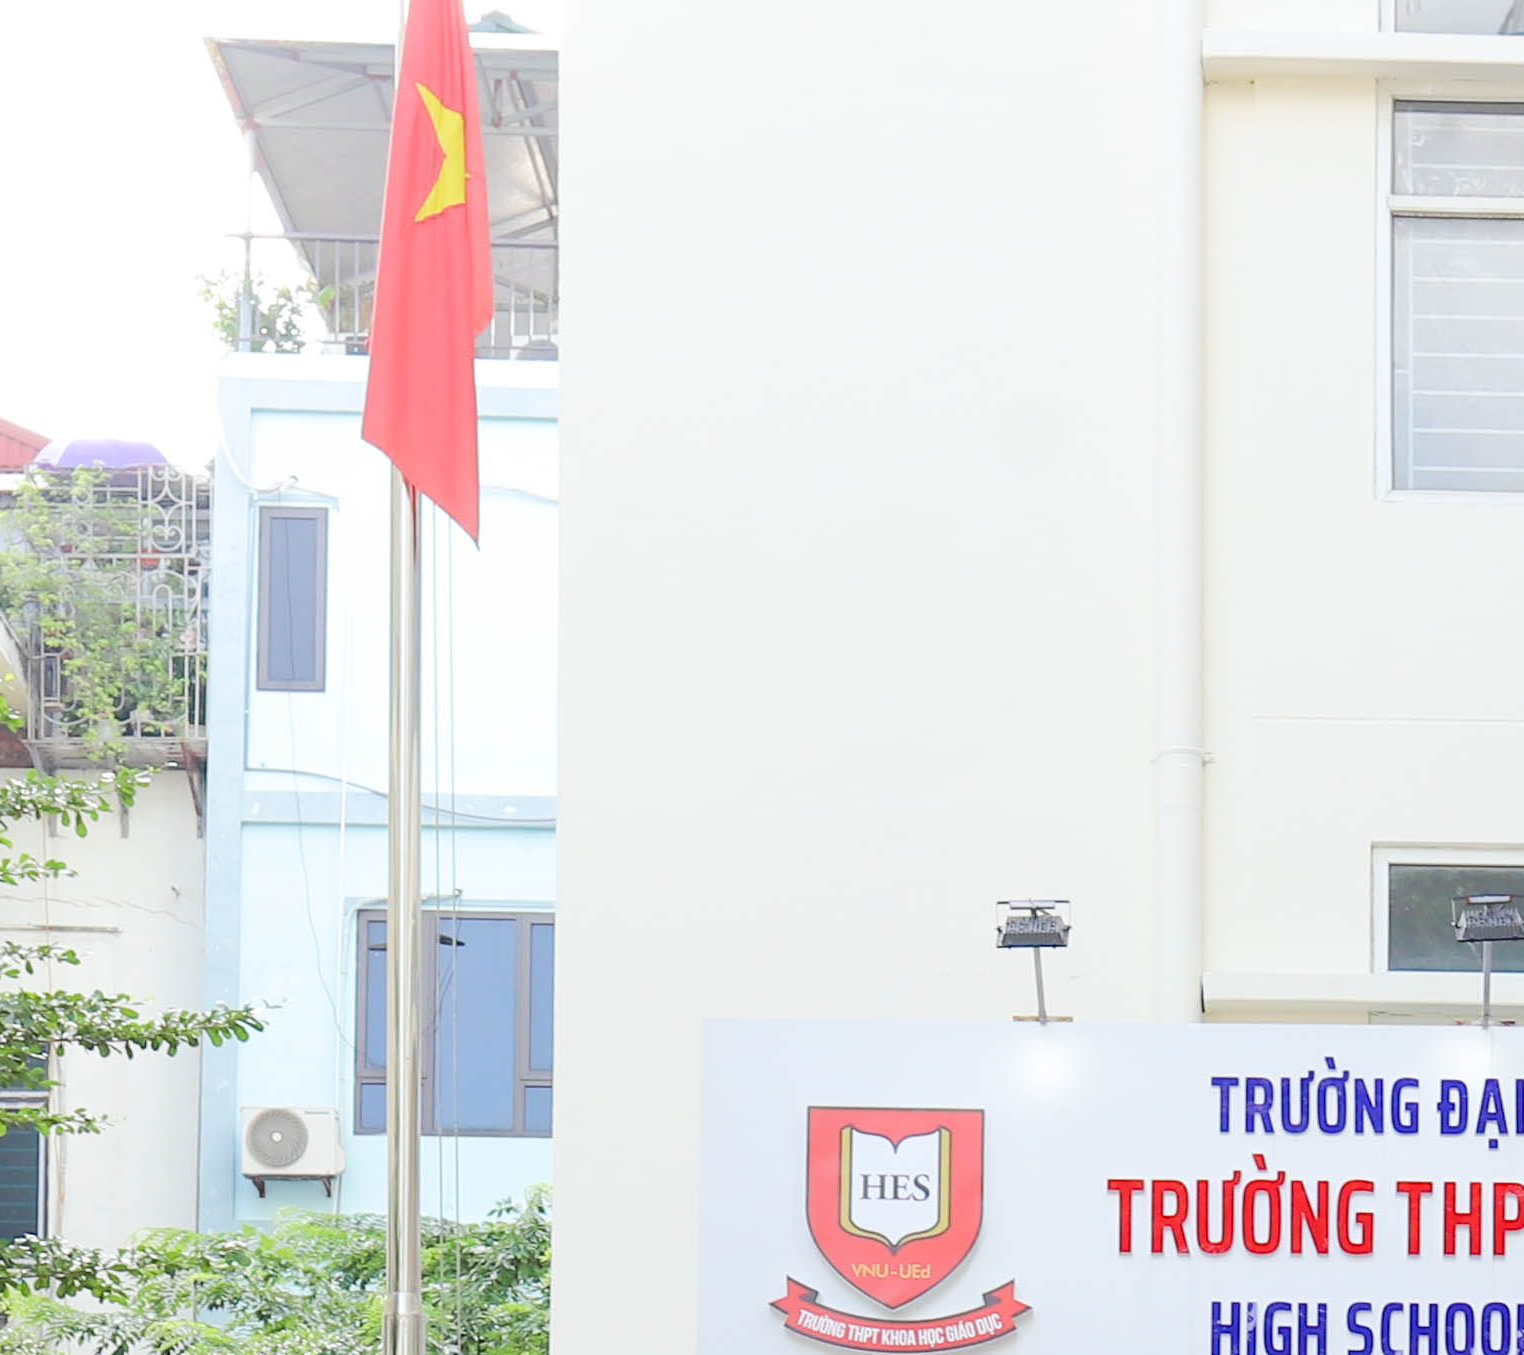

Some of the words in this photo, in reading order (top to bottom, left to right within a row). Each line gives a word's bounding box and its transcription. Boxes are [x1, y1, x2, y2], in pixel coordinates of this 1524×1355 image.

[1210, 1056, 1420, 1135] TRƯỜNG
[859, 1173, 931, 1201] HES
[1107, 1153, 1375, 1256] TRƯỜNG
[852, 1263, 889, 1278] VNU
[900, 1264, 931, 1279] UEd
[797, 1309, 845, 1338] TRƯỜNG
[848, 1324, 880, 1344] THPT
[881, 1329, 916, 1345] KHOA
[919, 1328, 944, 1347] HỌC
[946, 1318, 975, 1342] GIÁO
[976, 1313, 1003, 1336] DỤC
